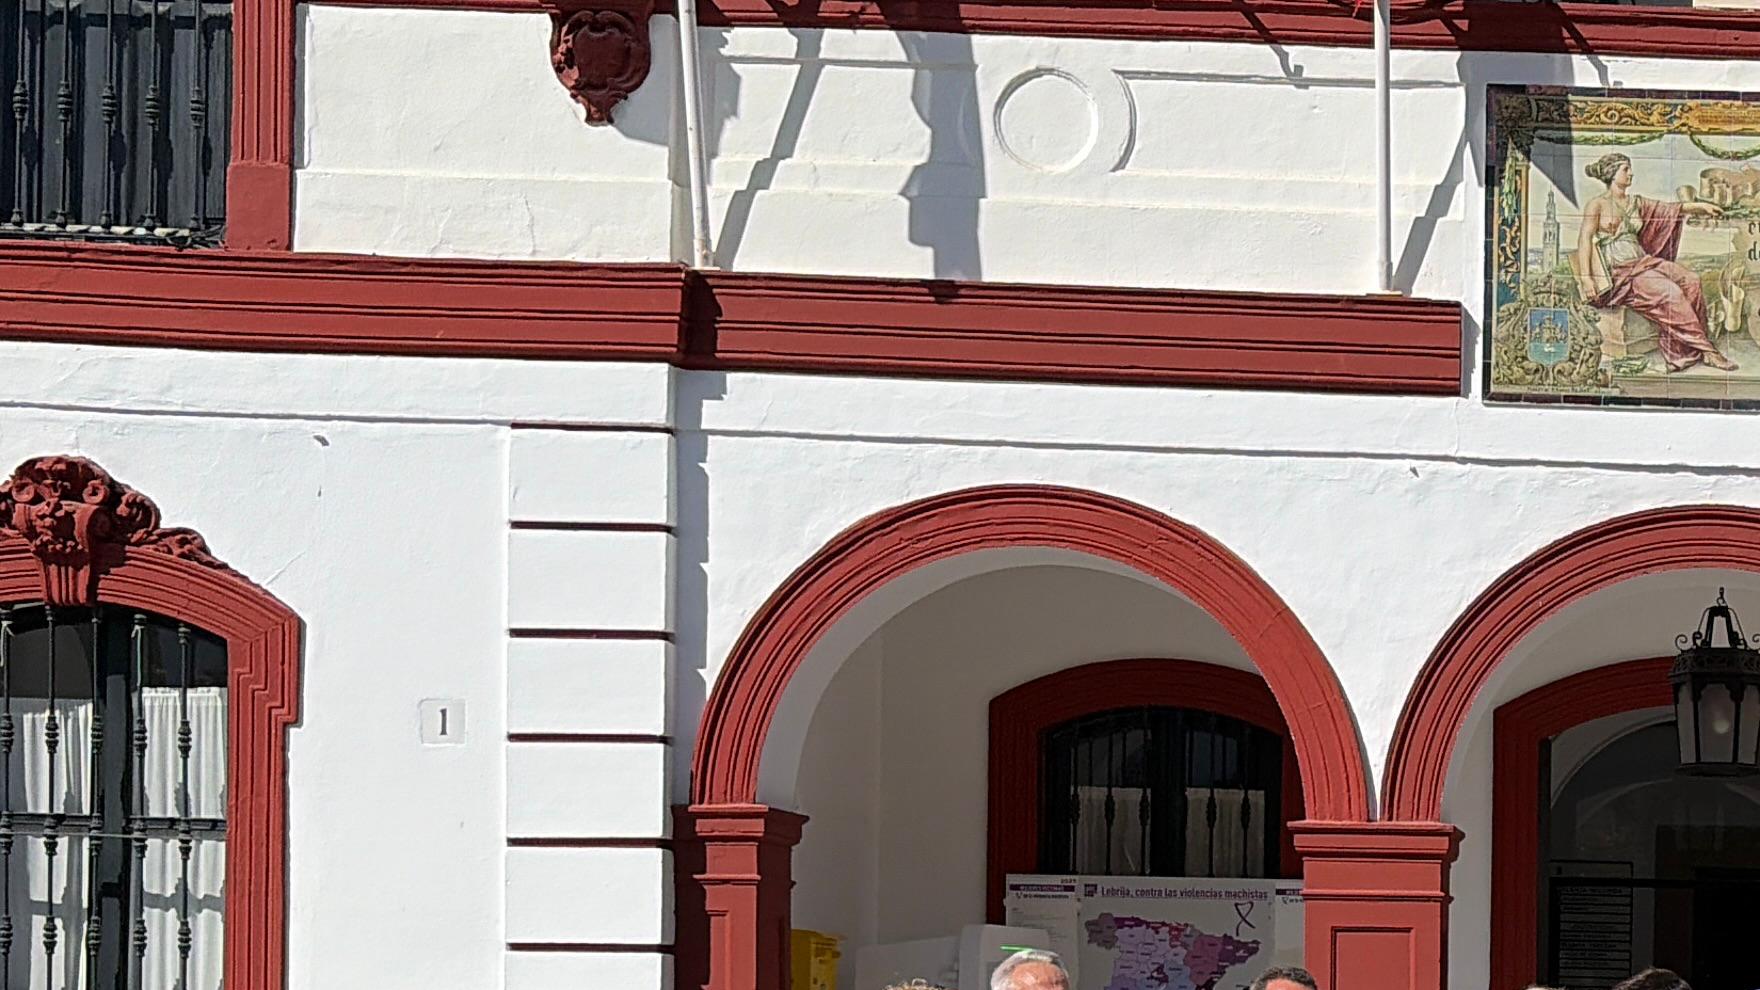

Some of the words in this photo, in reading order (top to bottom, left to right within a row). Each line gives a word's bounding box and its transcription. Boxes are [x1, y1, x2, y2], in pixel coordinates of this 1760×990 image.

[439, 707, 448, 736] 1
[1135, 887, 1163, 898] contra
[1164, 887, 1178, 897] las
[1179, 888, 1223, 898] violencias
[1224, 888, 1268, 899] machistas
